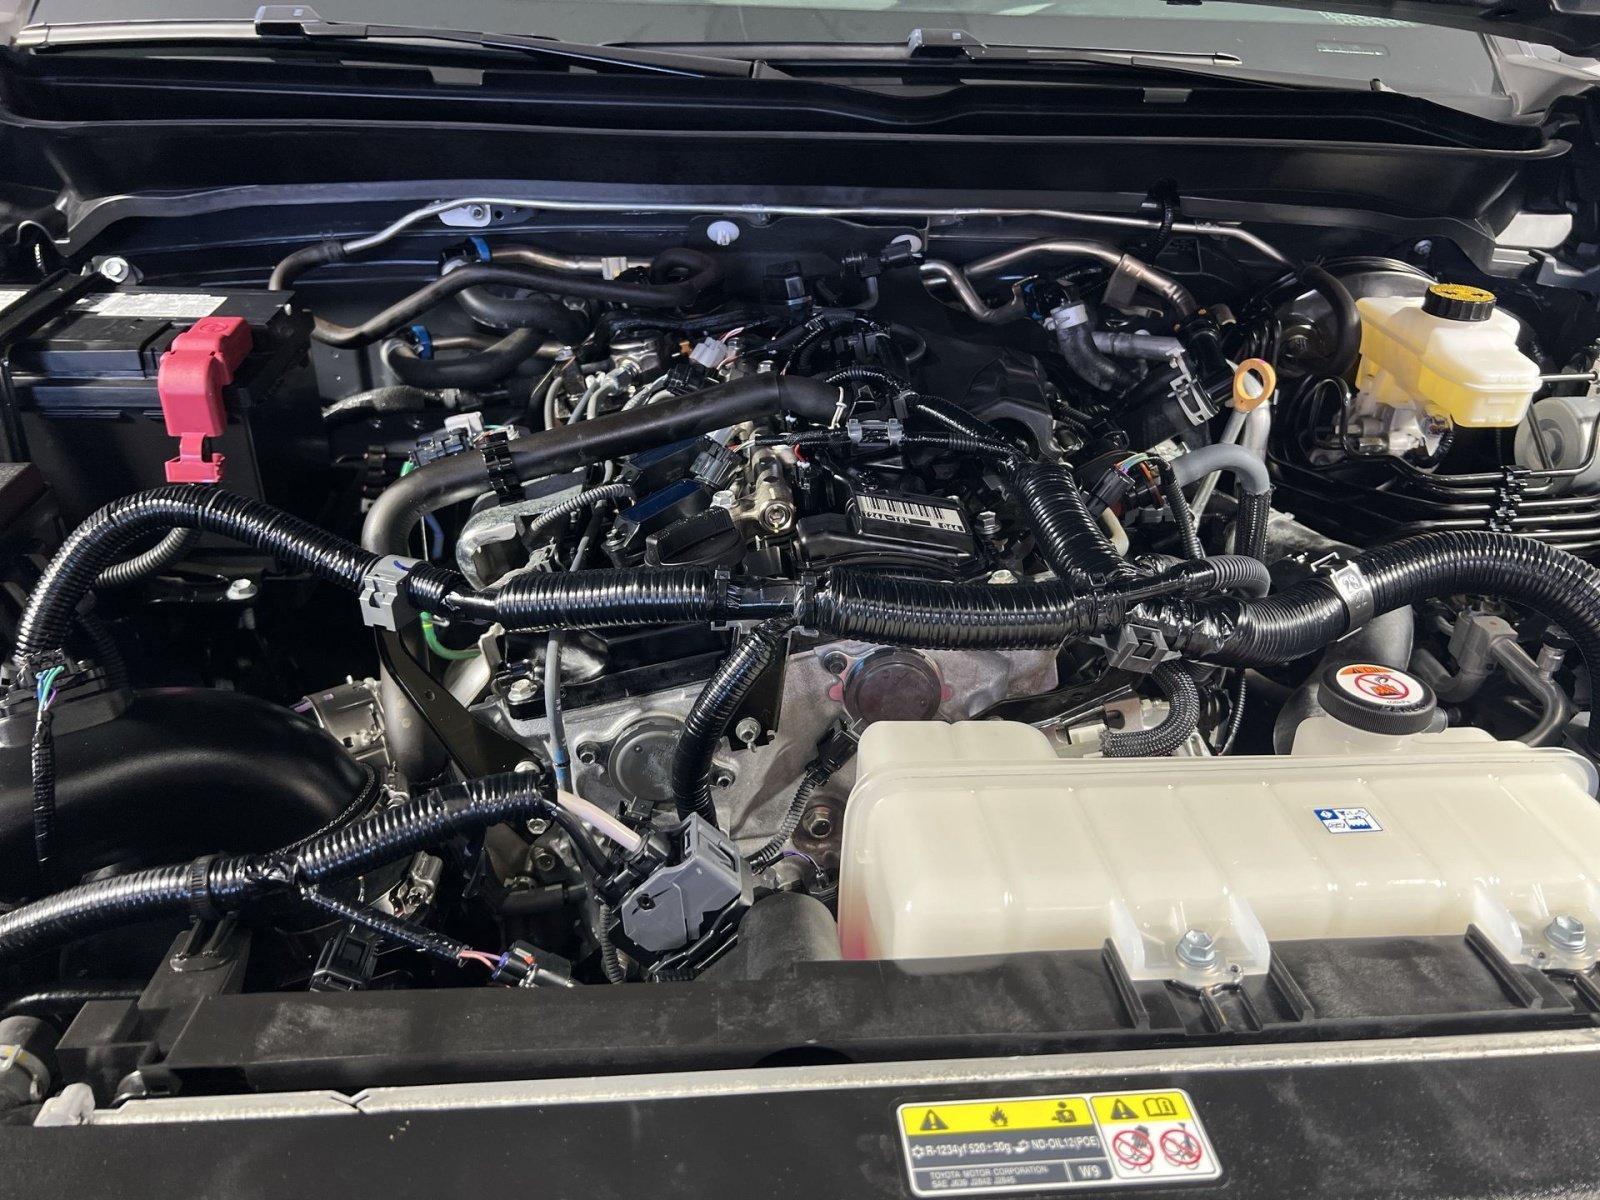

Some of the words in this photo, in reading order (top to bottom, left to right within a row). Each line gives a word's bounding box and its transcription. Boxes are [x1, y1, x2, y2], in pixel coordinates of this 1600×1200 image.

[925, 1142, 967, 1158] R-1234yf
[1030, 1135, 1101, 1150] ND-OIL12(POE)
[930, 1170, 961, 1180] TOYOTA
[962, 1168, 991, 1178] MOTOR
[993, 1165, 1049, 1177] CORPORATION
[1077, 1164, 1102, 1179] W9
[931, 1179, 948, 1189] SAE
